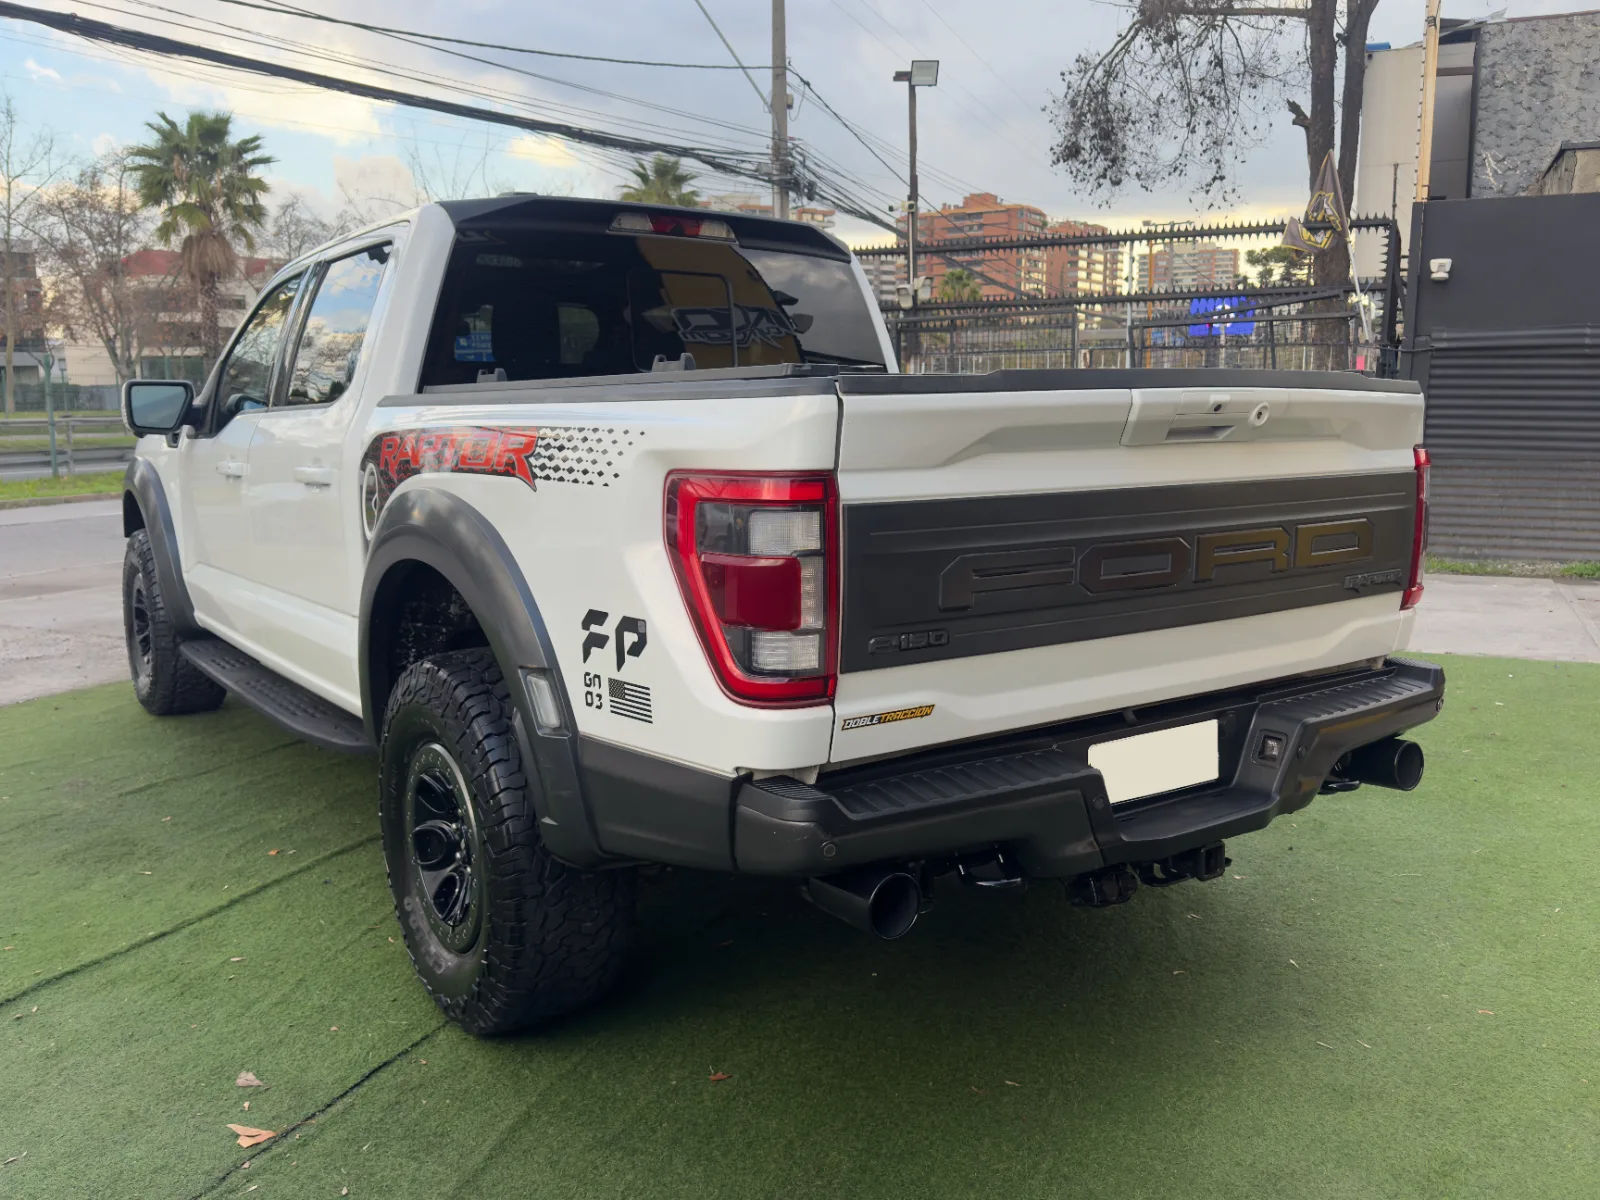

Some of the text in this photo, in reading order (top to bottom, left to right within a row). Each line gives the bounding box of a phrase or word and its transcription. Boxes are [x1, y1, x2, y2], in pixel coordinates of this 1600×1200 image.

[380, 431, 537, 492] RAPTOR
[940, 519, 1374, 610] FORD
[581, 608, 648, 673] FP
[868, 629, 949, 655] F-150
[585, 690, 603, 710] 03
